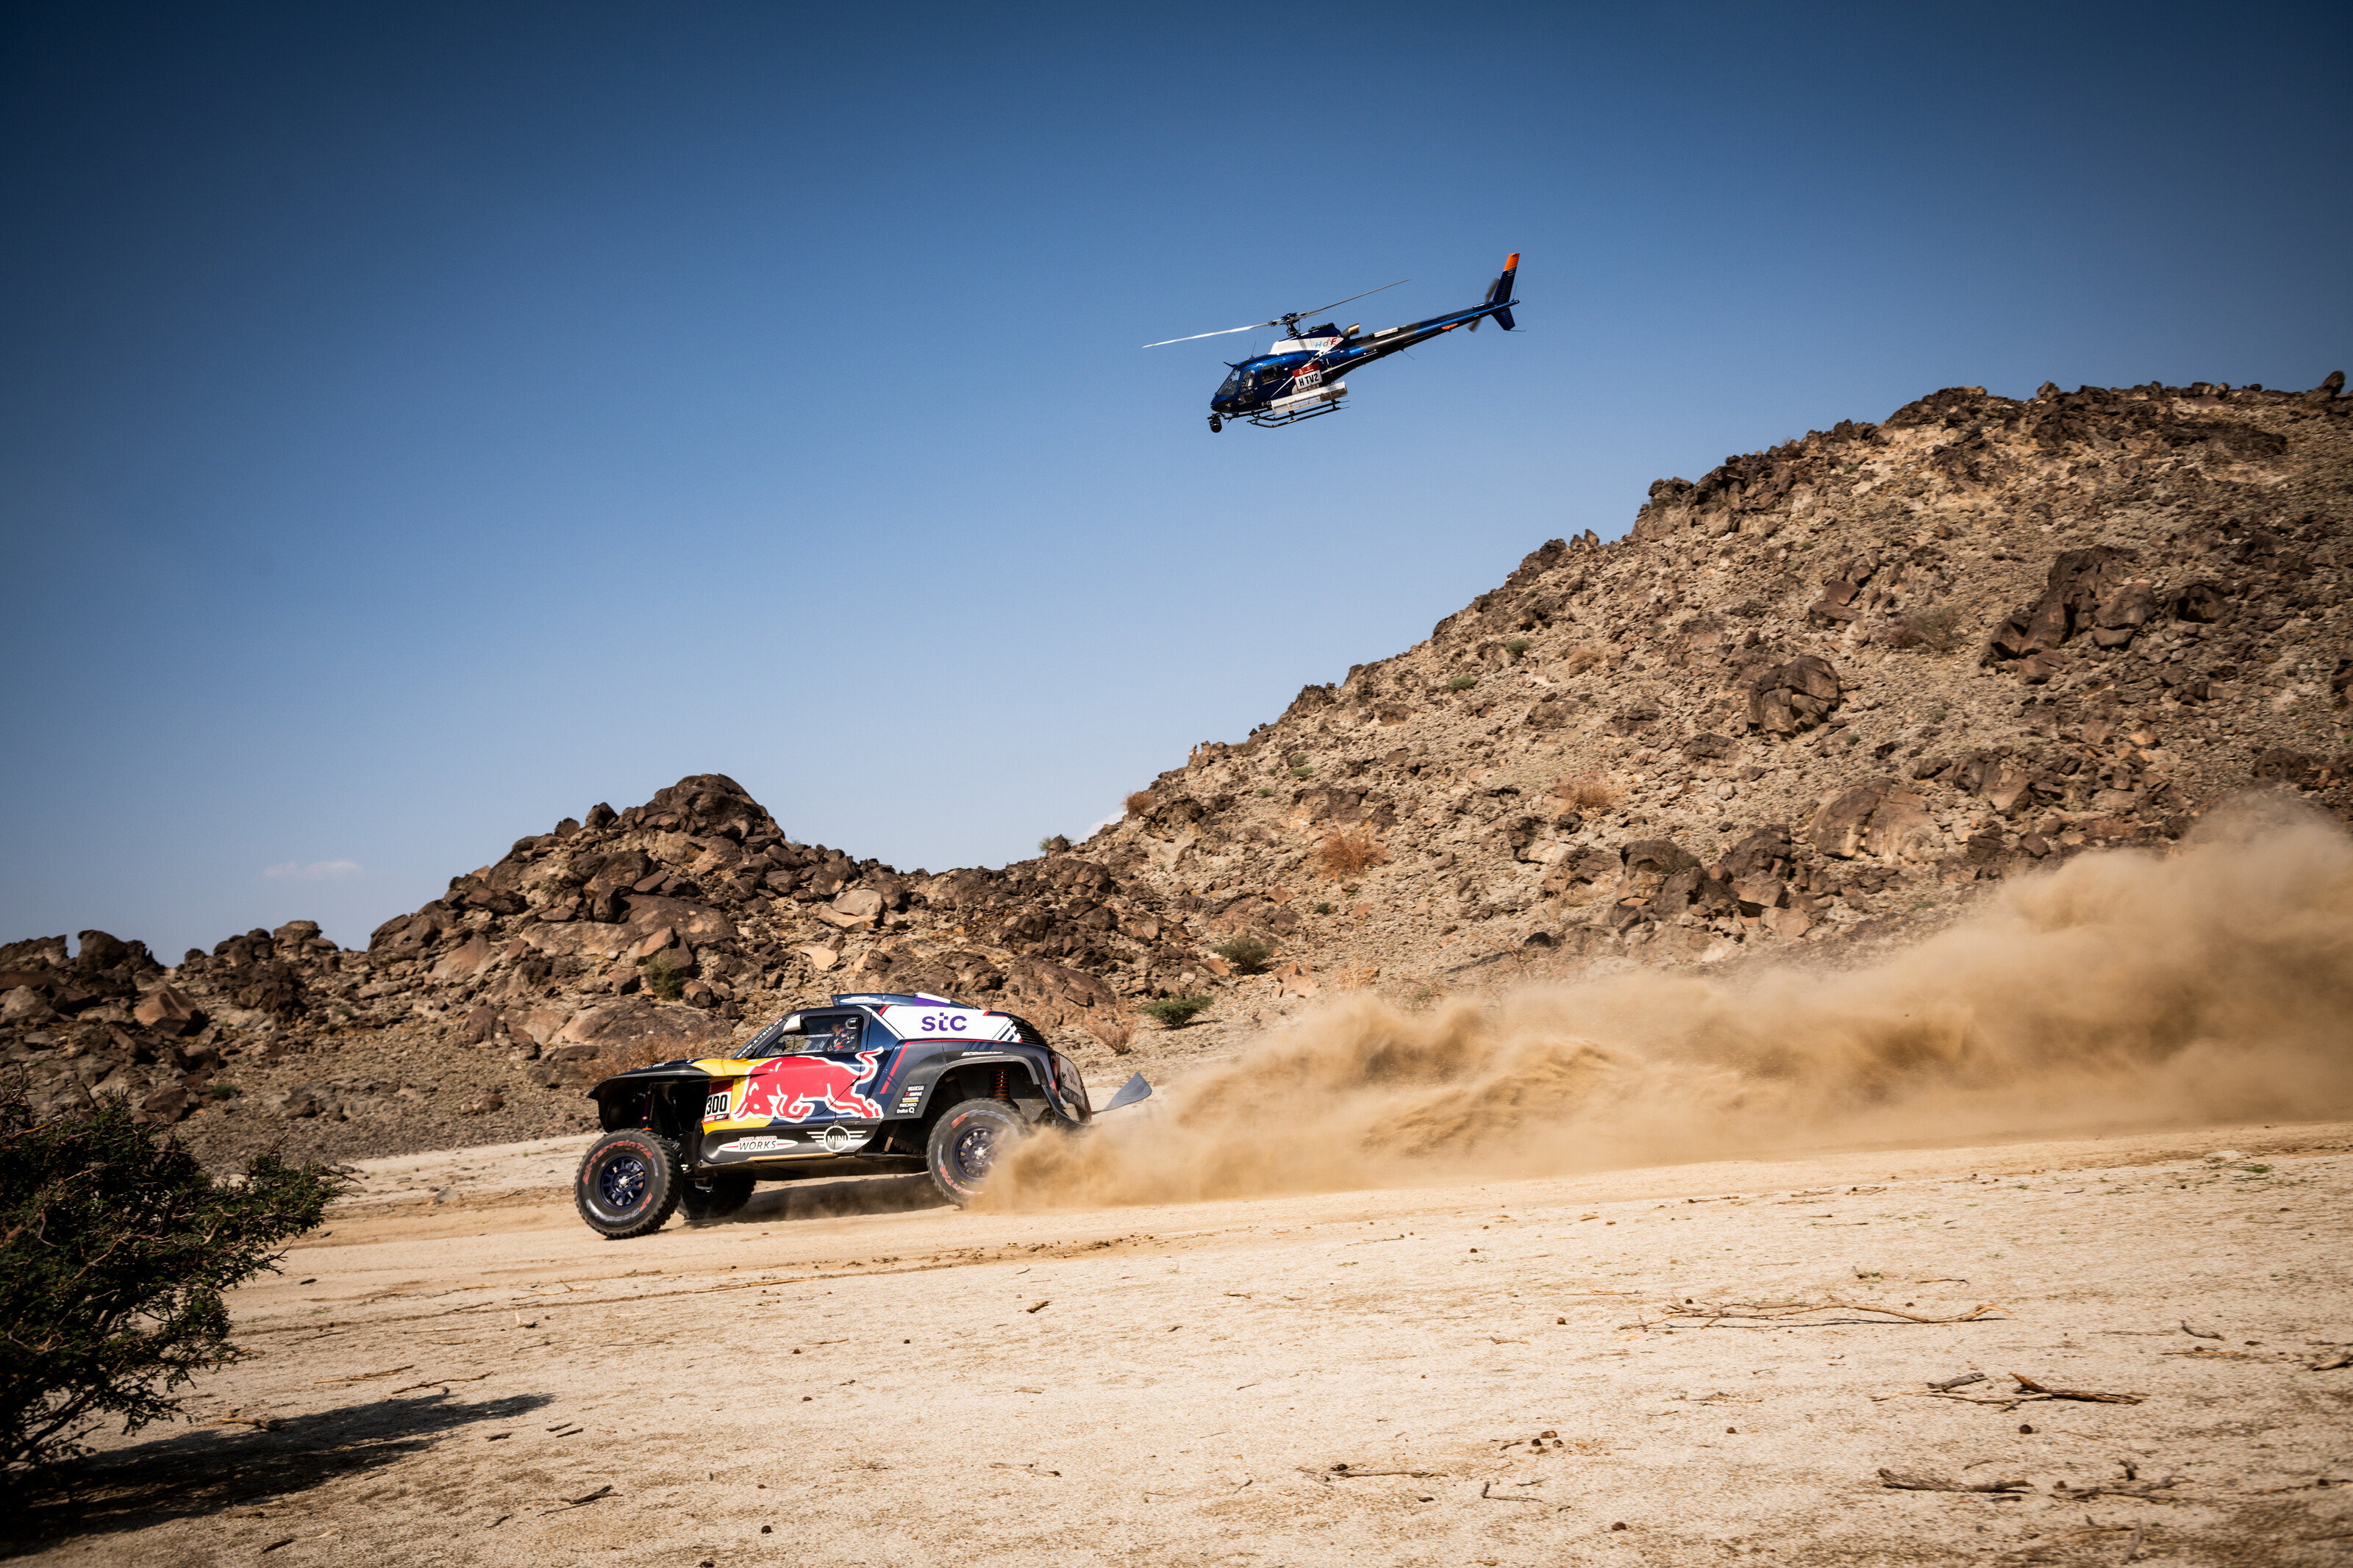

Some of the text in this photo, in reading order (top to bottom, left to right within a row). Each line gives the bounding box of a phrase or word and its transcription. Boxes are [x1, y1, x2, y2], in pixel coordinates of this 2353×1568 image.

[1299, 373, 1319, 387] H TV2
[921, 1012, 968, 1032] stc
[706, 1094, 729, 1116] 300
[739, 1140, 777, 1150] WORKS
[826, 1134, 847, 1143] MINI
